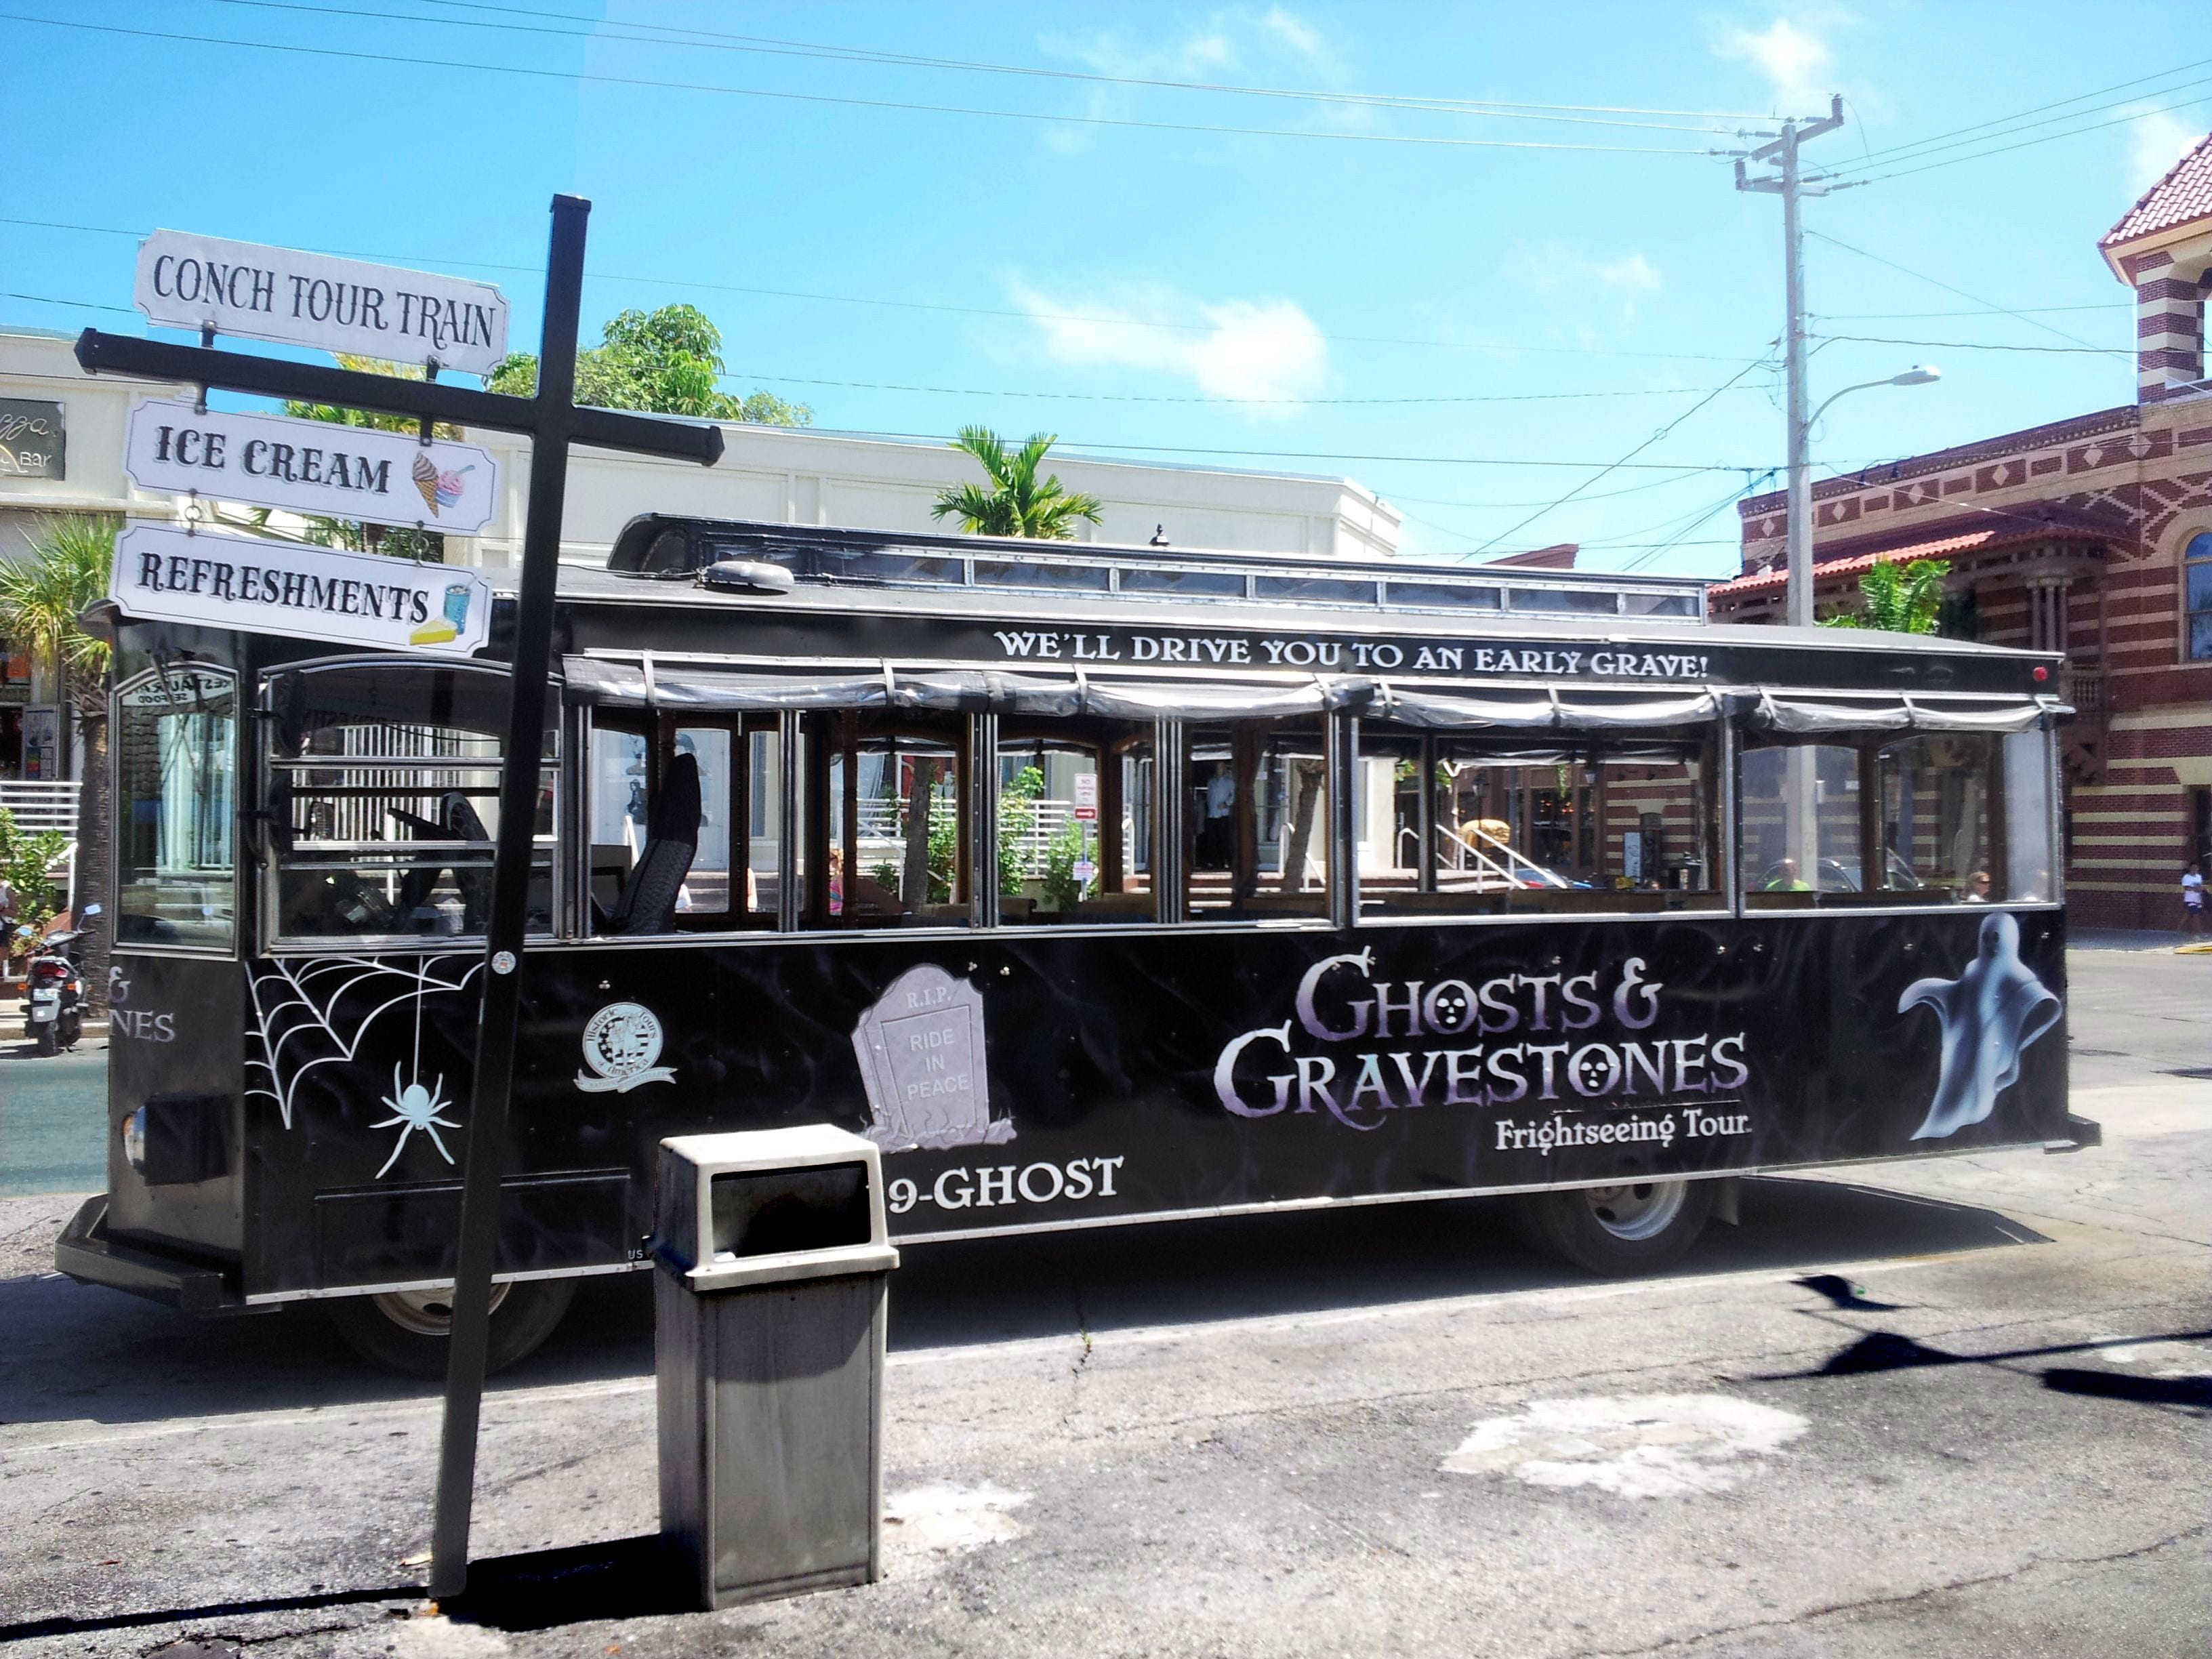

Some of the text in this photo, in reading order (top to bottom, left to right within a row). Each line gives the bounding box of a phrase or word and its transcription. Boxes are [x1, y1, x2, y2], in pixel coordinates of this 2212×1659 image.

[154, 255, 496, 350] CONCH TOUR TRAIN
[20, 451, 52, 467] Bar
[156, 425, 392, 493] ICE CREAM
[139, 552, 430, 623] REFRESHMENTS
[994, 631, 1708, 678] WE'LL DRIVE YOU TO AN EARLY GRAVE!
[108, 966, 131, 1003] &
[906, 987, 951, 1008] R.I.P.
[1296, 945, 1664, 1042] GHOSTS &
[587, 1008, 619, 1042] Historic
[910, 1029, 955, 1051] RIDE
[926, 1054, 945, 1073] IN
[1213, 1019, 1750, 1132] GRAVESTONES
[907, 1074, 969, 1101] PEACE
[1495, 1107, 1749, 1156] Frightseeing Tour
[888, 1156, 1125, 1214] 9-GHOST
[628, 1249, 644, 1259] US
